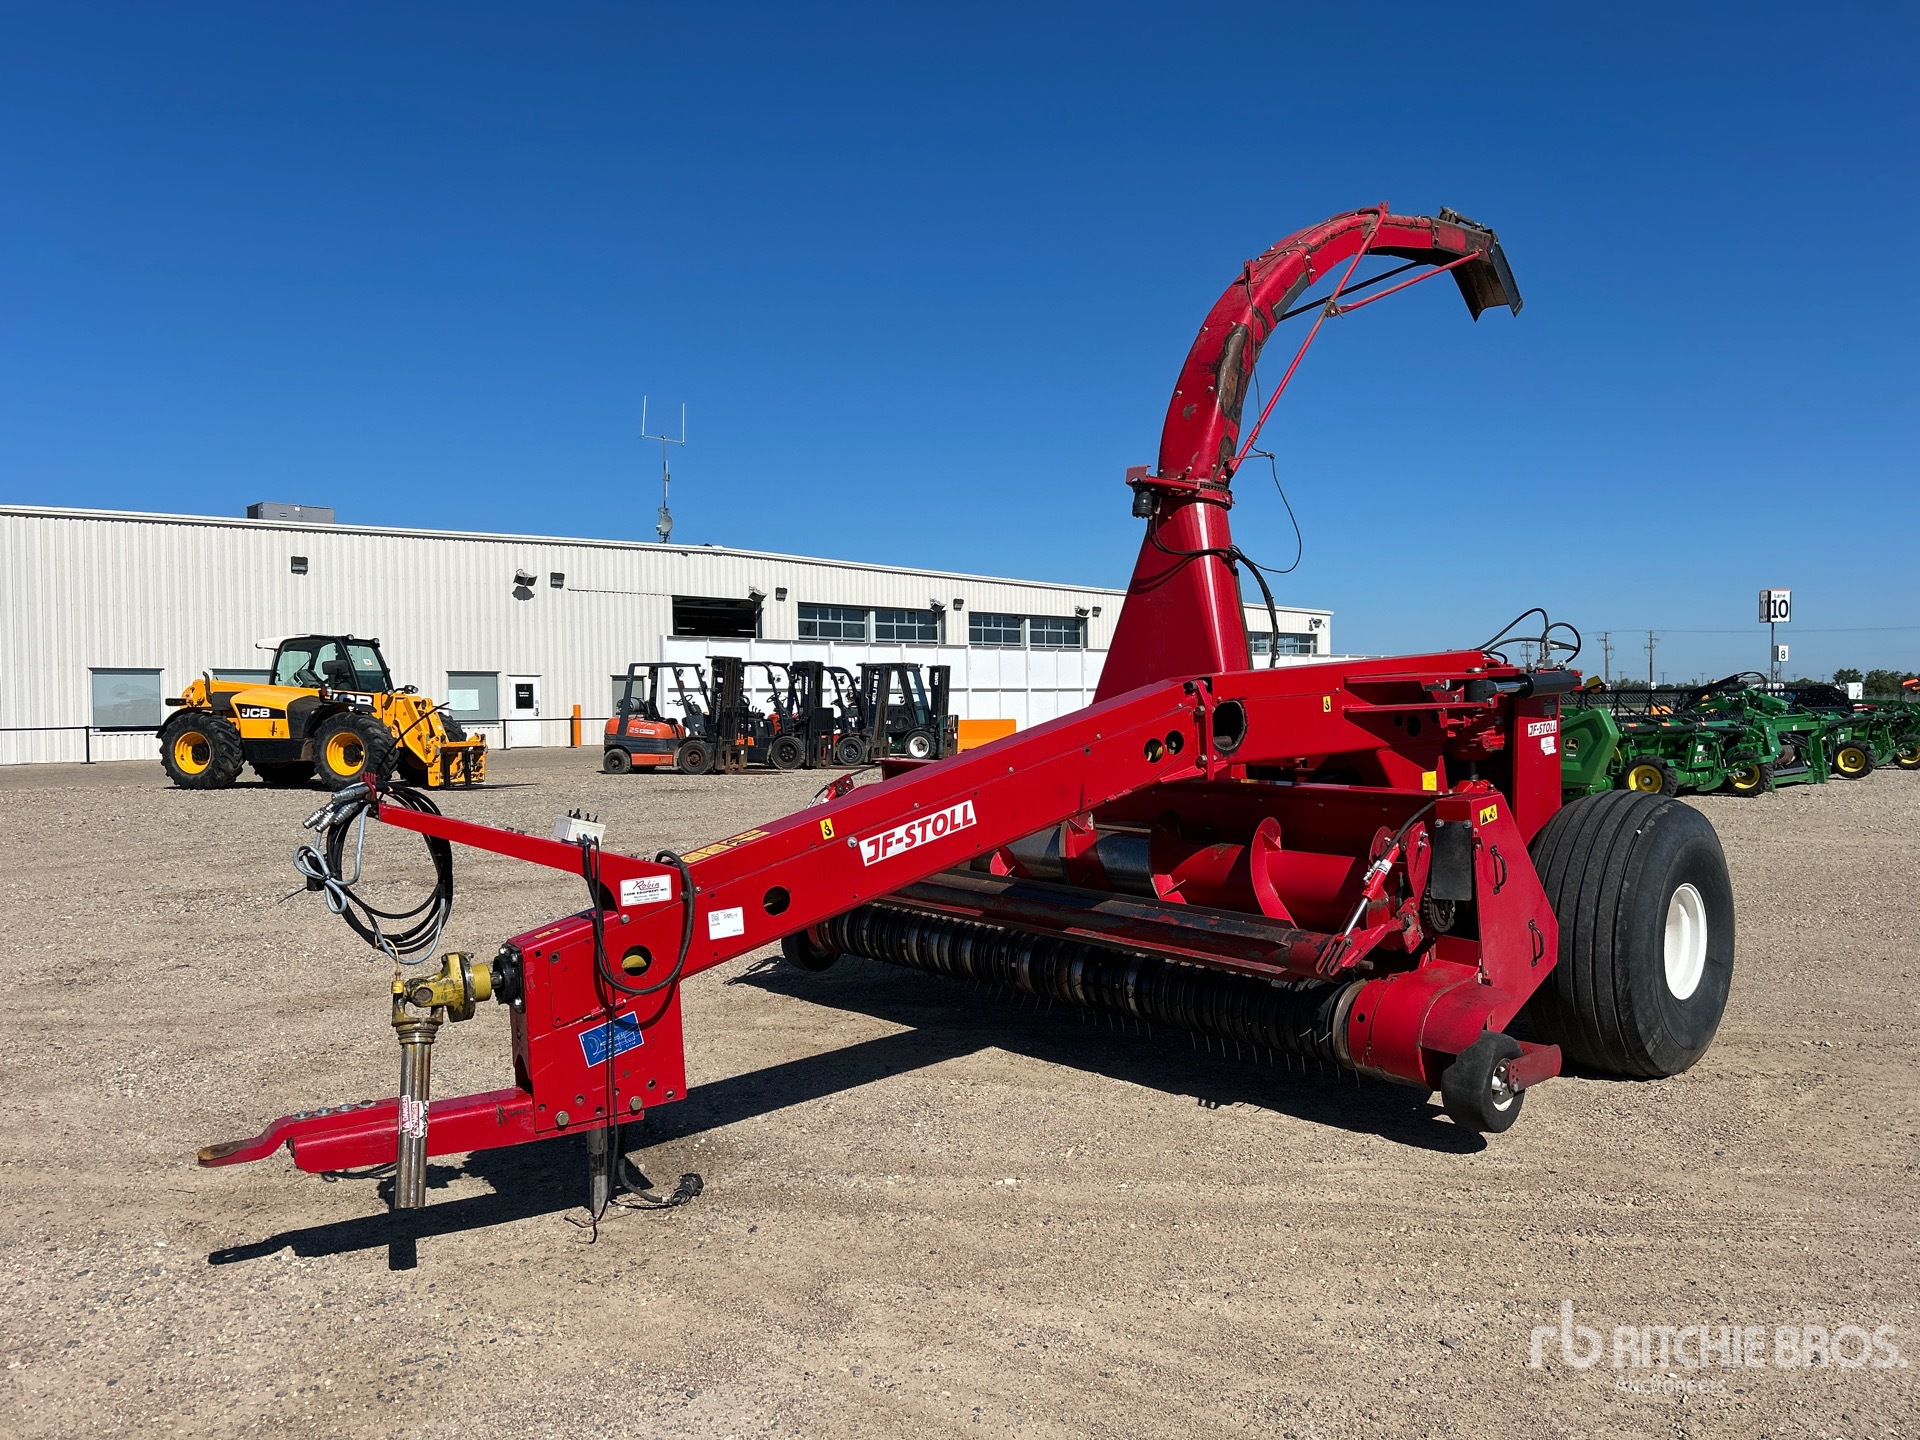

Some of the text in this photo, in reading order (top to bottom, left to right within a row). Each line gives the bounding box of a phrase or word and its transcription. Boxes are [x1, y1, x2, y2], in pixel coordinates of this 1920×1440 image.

[1771, 599, 1789, 618] 10
[1780, 649, 1786, 660] 8
[241, 708, 270, 718] JCB
[1528, 721, 1557, 735] JF-STOLL
[866, 804, 973, 864] JF-STOLL
[632, 880, 660, 890] Robin
